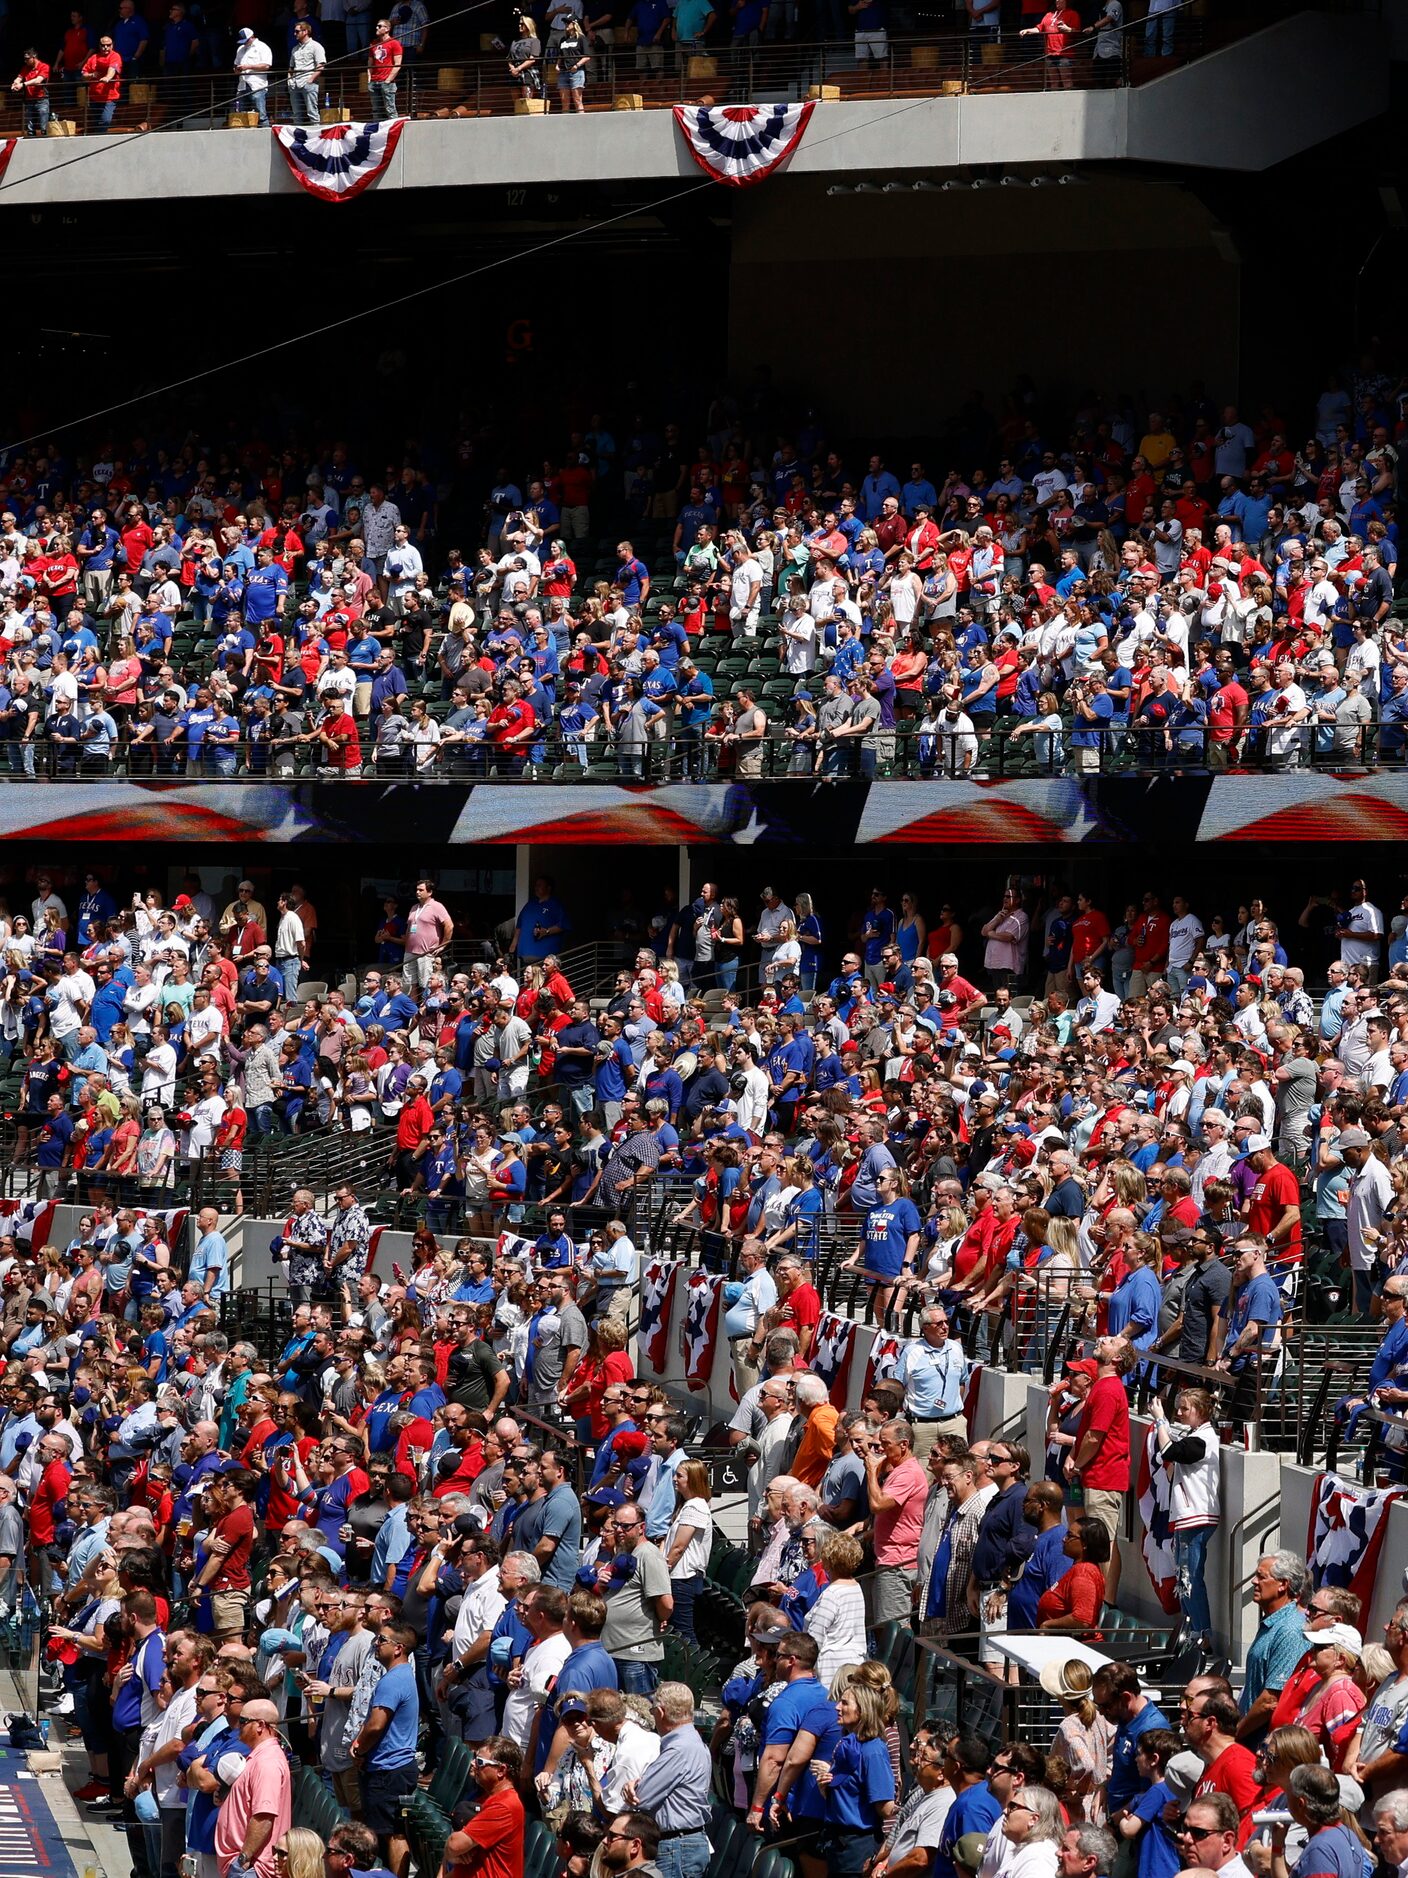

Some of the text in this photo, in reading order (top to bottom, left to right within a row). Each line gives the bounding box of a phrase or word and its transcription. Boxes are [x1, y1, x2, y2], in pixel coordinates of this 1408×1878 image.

[506, 189, 527, 206] 127
[94, 469, 112, 477] TEXAS
[38, 483, 49, 499] T
[493, 493, 505, 503] T
[684, 511, 704, 519] TEXAS
[1054, 518, 1068, 527] T
[47, 564, 64, 572] TEXAS
[865, 559, 872, 568] T
[248, 575, 268, 584] EXAS
[581, 677, 591, 689] T
[643, 681, 661, 690] EXAS
[1252, 701, 1269, 713] EXAS
[79, 901, 100, 912] TEXAS
[1149, 923, 1157, 931] T
[1171, 928, 1188, 939] Rangers
[191, 1020, 209, 1028] TEXAS
[29, 1071, 50, 1081] ANGERS
[434, 1161, 444, 1174] T
[866, 1230, 889, 1242] STATE
[374, 1402, 399, 1413] EXA
[568, 1698, 575, 1706] T
[1123, 1739, 1132, 1754] T
